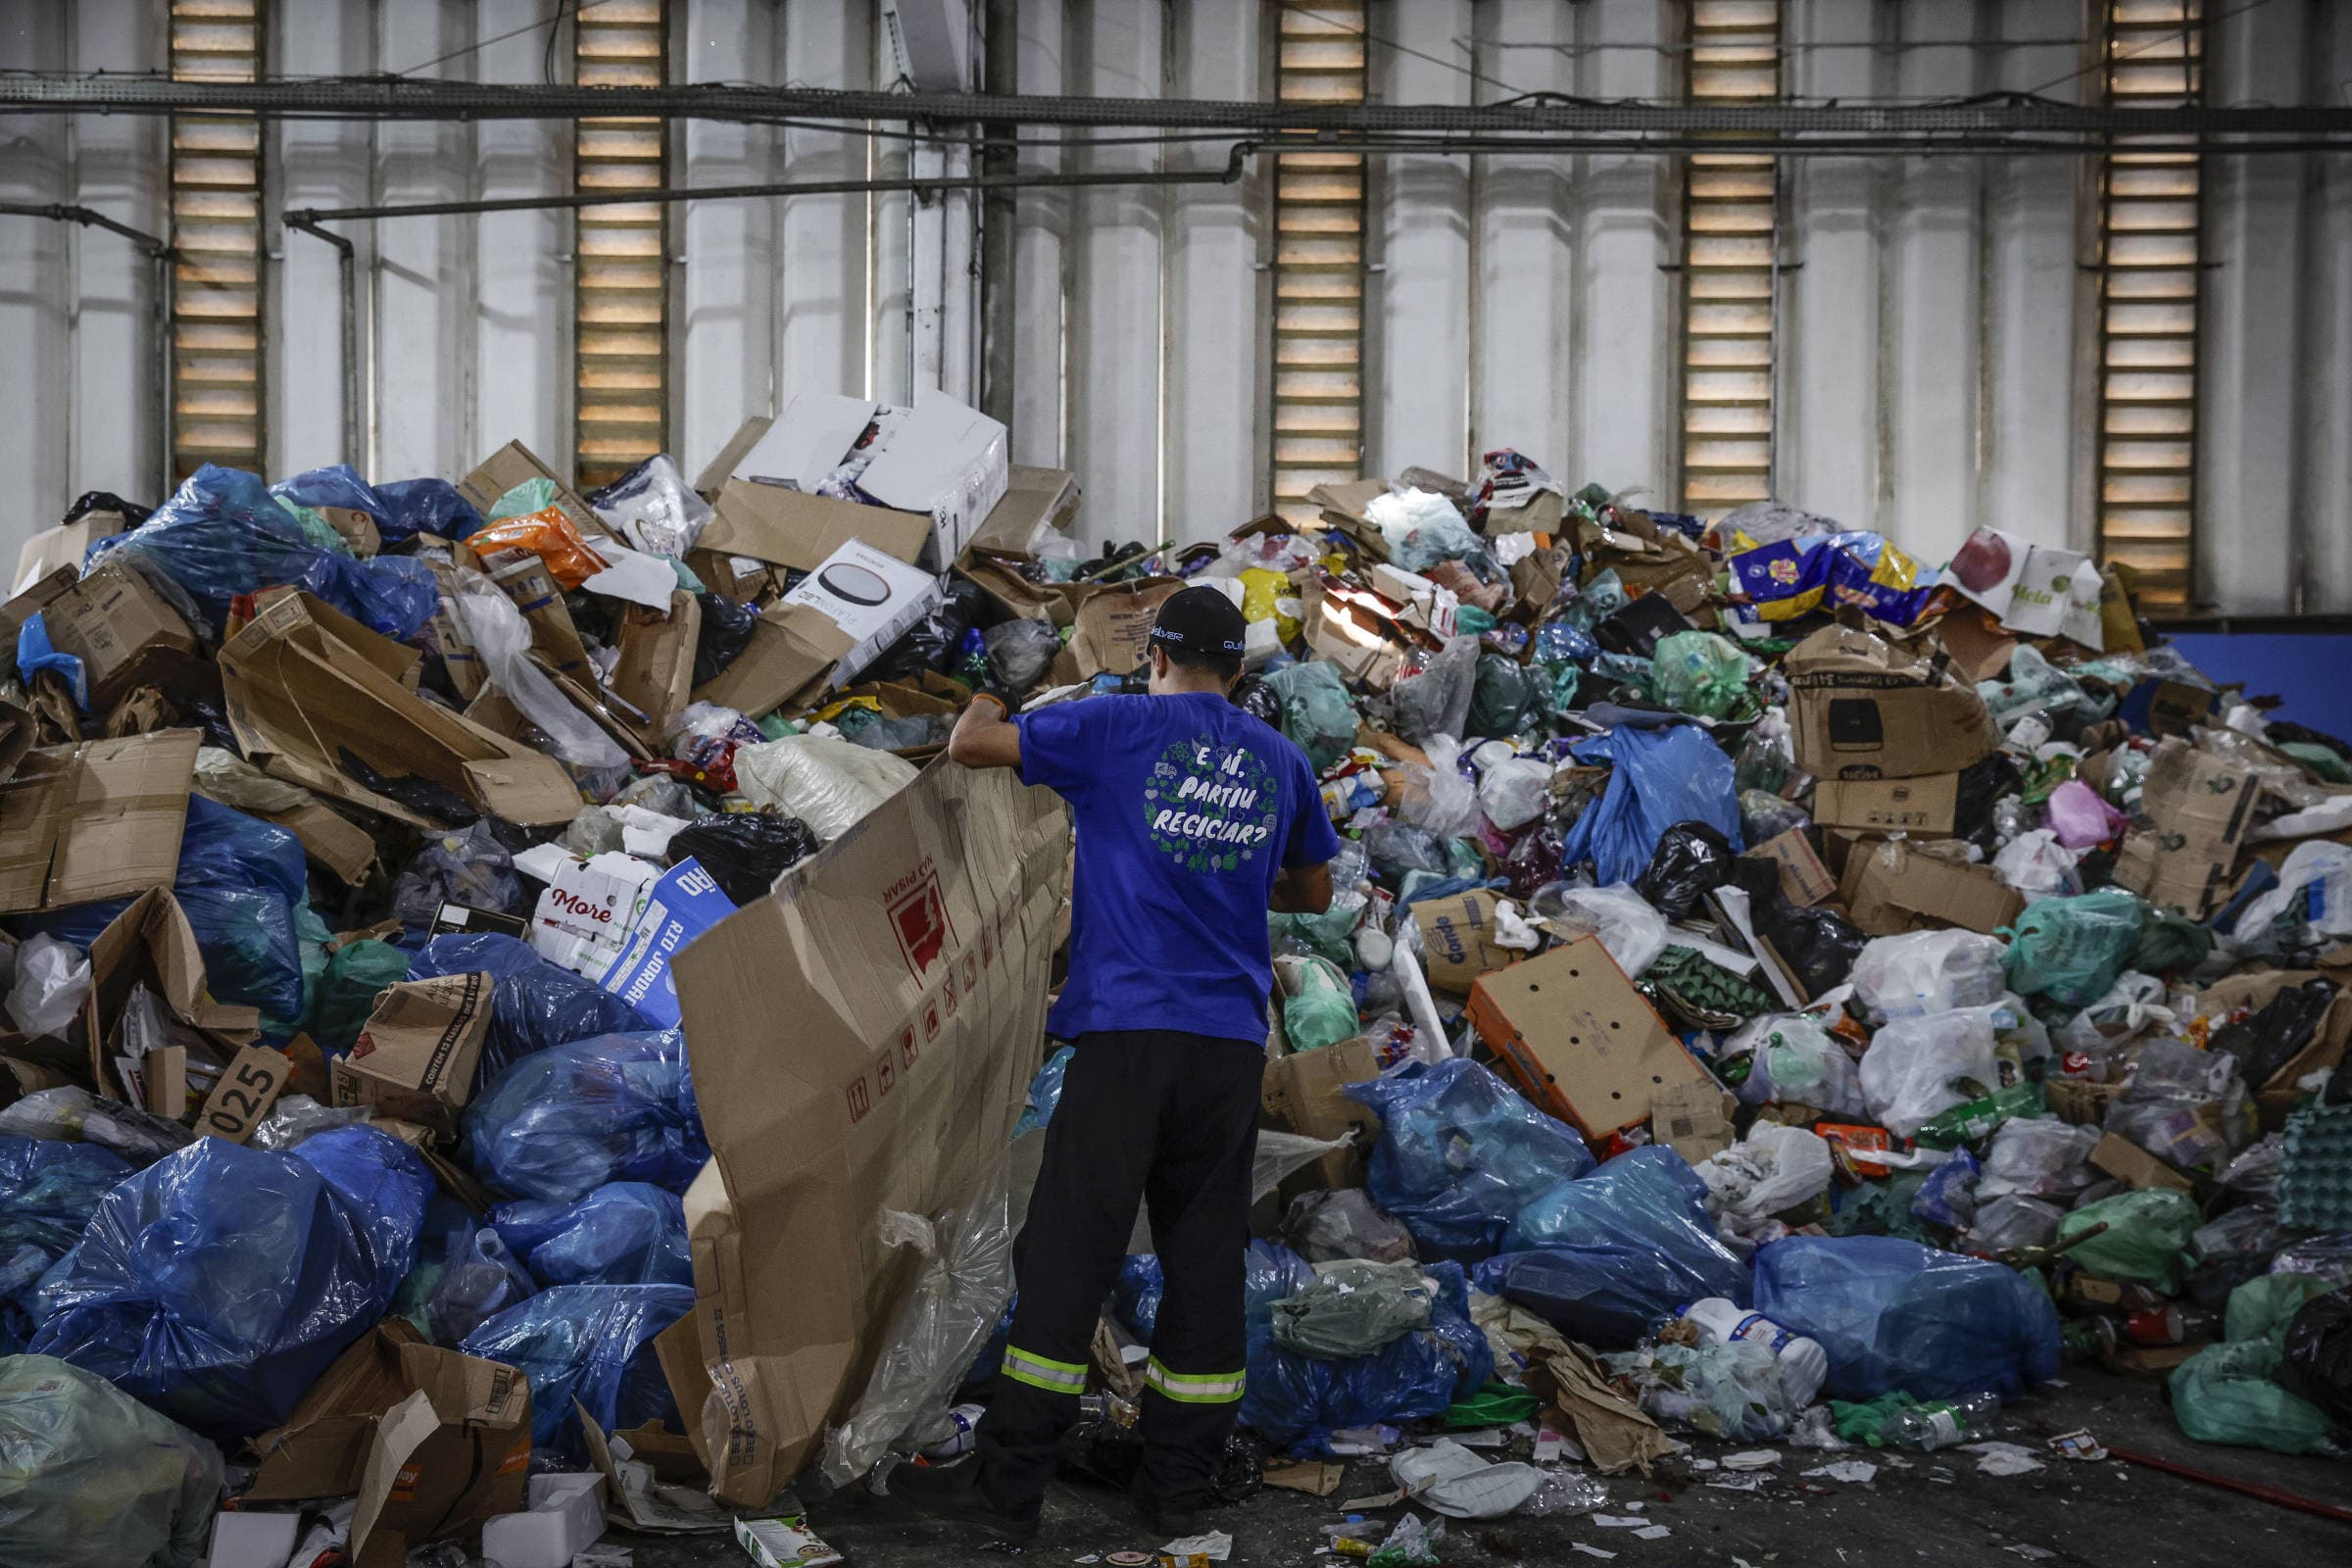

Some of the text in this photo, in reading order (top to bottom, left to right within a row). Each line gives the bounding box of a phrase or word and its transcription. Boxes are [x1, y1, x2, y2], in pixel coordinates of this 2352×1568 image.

[1197, 747, 1210, 765] E
[1178, 776, 1256, 809] PARTIU
[1153, 809, 1267, 845] RECICLAR?
[883, 870, 916, 903] PISAR
[552, 888, 612, 923] More
[661, 920, 684, 953] RIO
[425, 1052, 446, 1085] CONTÉM
[441, 1041, 452, 1053] 12
[210, 1063, 274, 1134] 025
